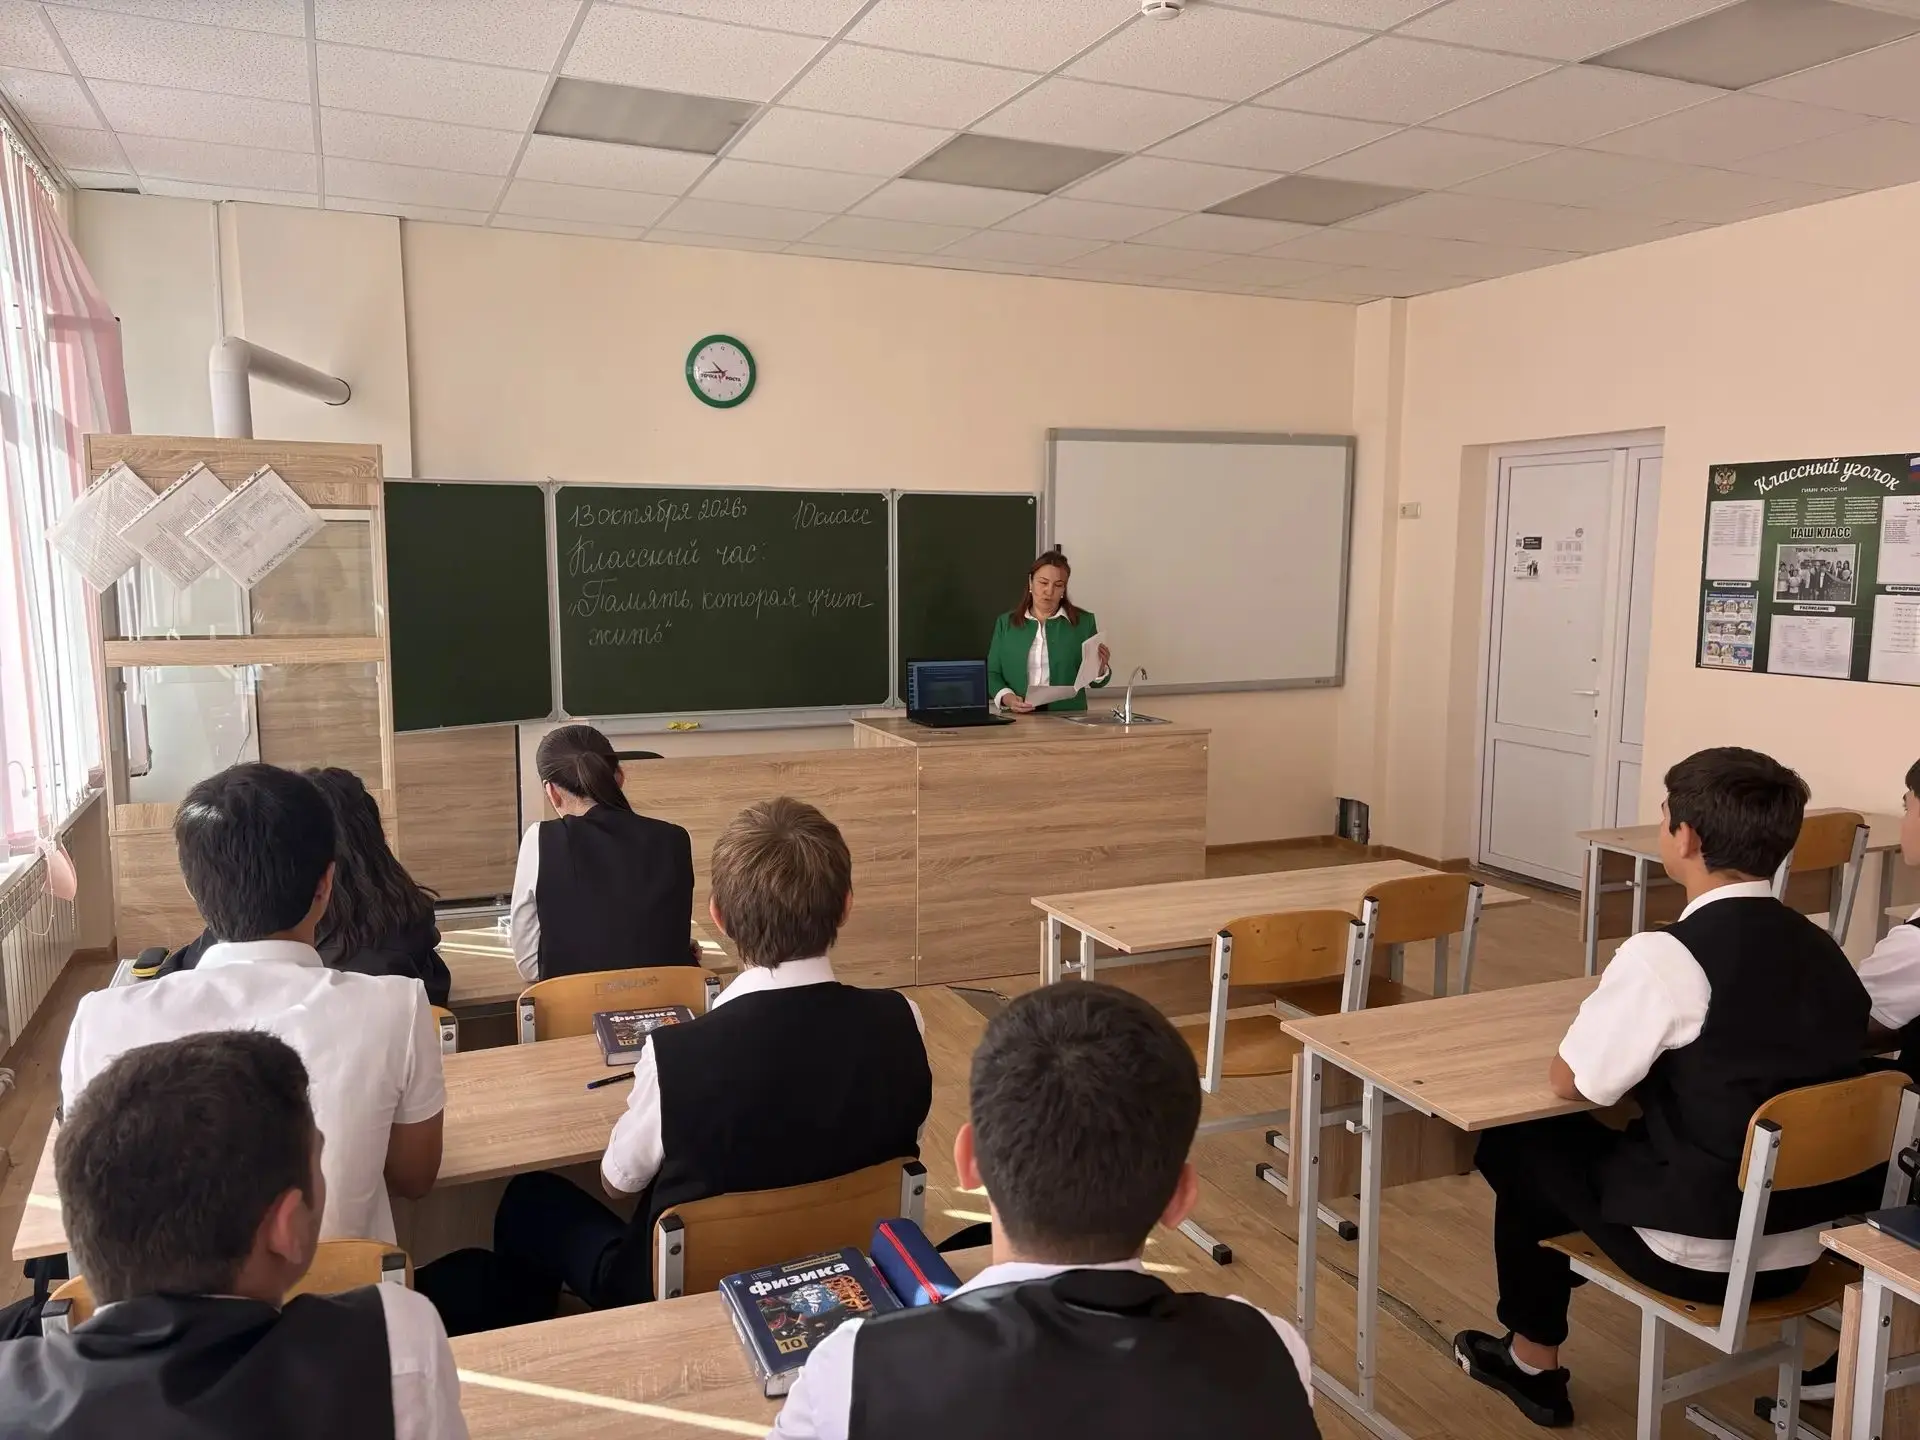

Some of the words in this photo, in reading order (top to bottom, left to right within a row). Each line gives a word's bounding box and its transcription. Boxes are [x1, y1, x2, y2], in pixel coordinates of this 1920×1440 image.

[1754, 457, 1840, 495] Классный
[1840, 461, 1901, 491] уголок
[1791, 527, 1814, 538] НАШ
[1816, 527, 1852, 538] КЛАСС
[566, 534, 700, 577] Классный
[701, 586, 801, 620] которая
[808, 587, 875, 617] учит
[609, 1011, 677, 1023] физика
[748, 1263, 851, 1296] физика
[779, 1338, 804, 1352] 10
